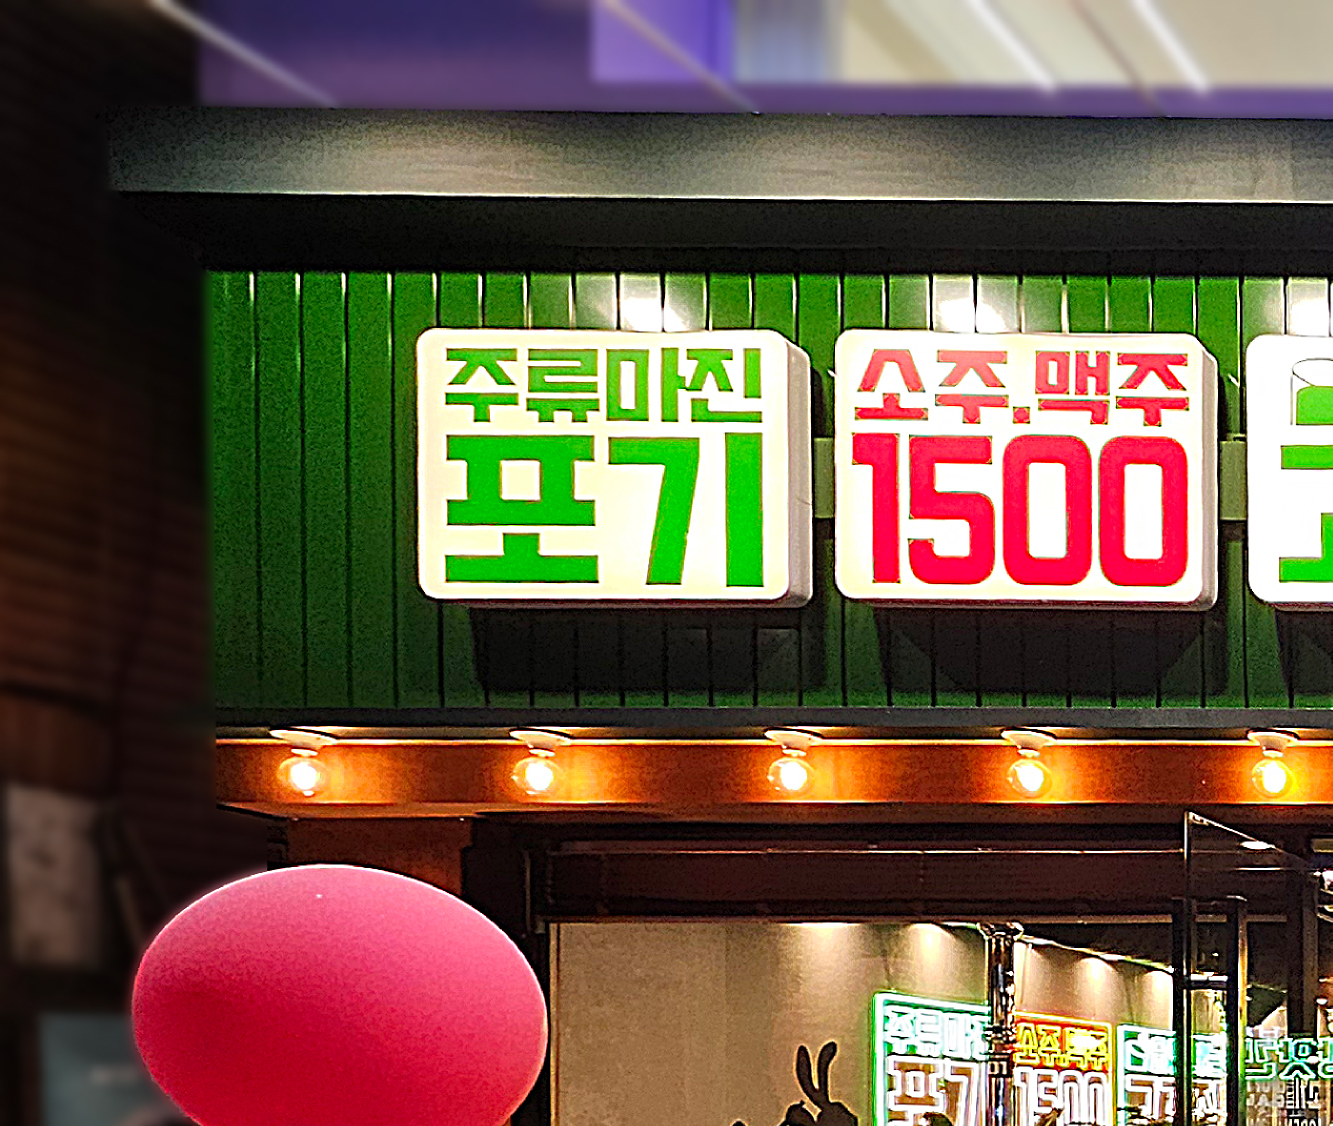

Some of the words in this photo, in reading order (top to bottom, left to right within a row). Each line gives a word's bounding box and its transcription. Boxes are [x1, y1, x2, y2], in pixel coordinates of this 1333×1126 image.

[444, 347, 764, 423] 주류마진
[854, 348, 1189, 426] 소주.맥주
[444, 431, 764, 588] 포기
[852, 432, 1188, 587] 1500
